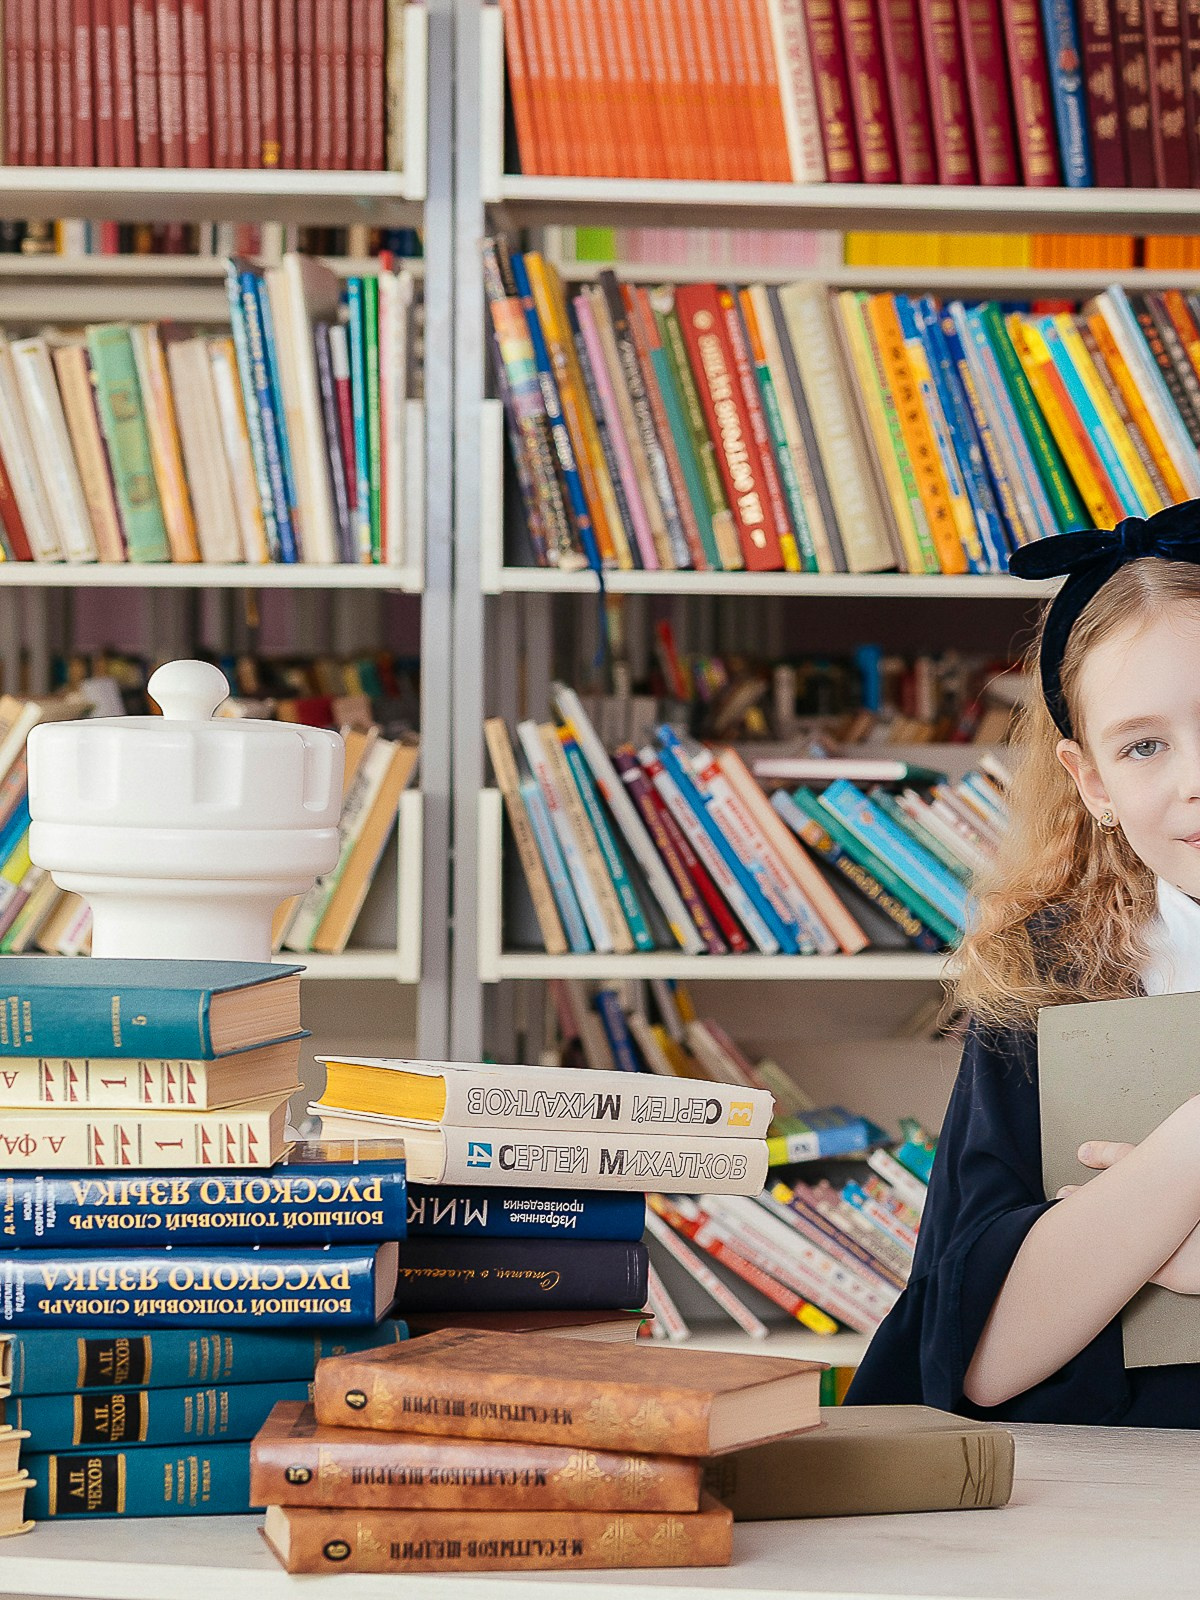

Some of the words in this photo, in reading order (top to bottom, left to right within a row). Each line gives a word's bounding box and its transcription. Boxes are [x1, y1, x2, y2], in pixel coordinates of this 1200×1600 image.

[101, 1076, 127, 1090] 1
[467, 1088, 621, 1120] МИХАЛКОВ
[632, 1096, 722, 1127] СЕРГЕЙ
[730, 1104, 752, 1121] 3
[0, 1133, 37, 1158] ФА
[42, 1136, 66, 1154] А.
[155, 1136, 184, 1151] 1
[469, 1144, 492, 1165] 4
[499, 1142, 589, 1173] СЕРГЕЙ
[599, 1148, 747, 1180] МИХАЛКОВ
[73, 1179, 190, 1206] ЯЗЫКА
[199, 1177, 384, 1203] РУССКОГО
[407, 1196, 488, 1226] М.И.К
[503, 1199, 585, 1213] произведения
[69, 1213, 161, 1231] СЛОВАРЬ
[164, 1211, 280, 1231] ТОЛКОВЫЙ
[283, 1209, 385, 1229] БОЛЬШОЙ
[510, 1211, 577, 1228] Избранные
[42, 1264, 159, 1292] ЯЗЫКА
[163, 1264, 352, 1292] РУССКОГО
[400, 1267, 475, 1284] классика
[480, 1269, 489, 1277] о
[497, 1268, 561, 1292] Статьи
[38, 1298, 130, 1315] СЛОВАРЬ
[133, 1298, 247, 1317] ТОЛКОВЫЙ
[251, 1297, 353, 1316] БОЛЬШОЙ
[115, 1337, 129, 1385] ЧЕХОВ
[111, 1394, 126, 1442] ЧЕХОВ
[88, 1458, 102, 1510] ЧЕХОВ
[291, 1467, 309, 1482] 5
